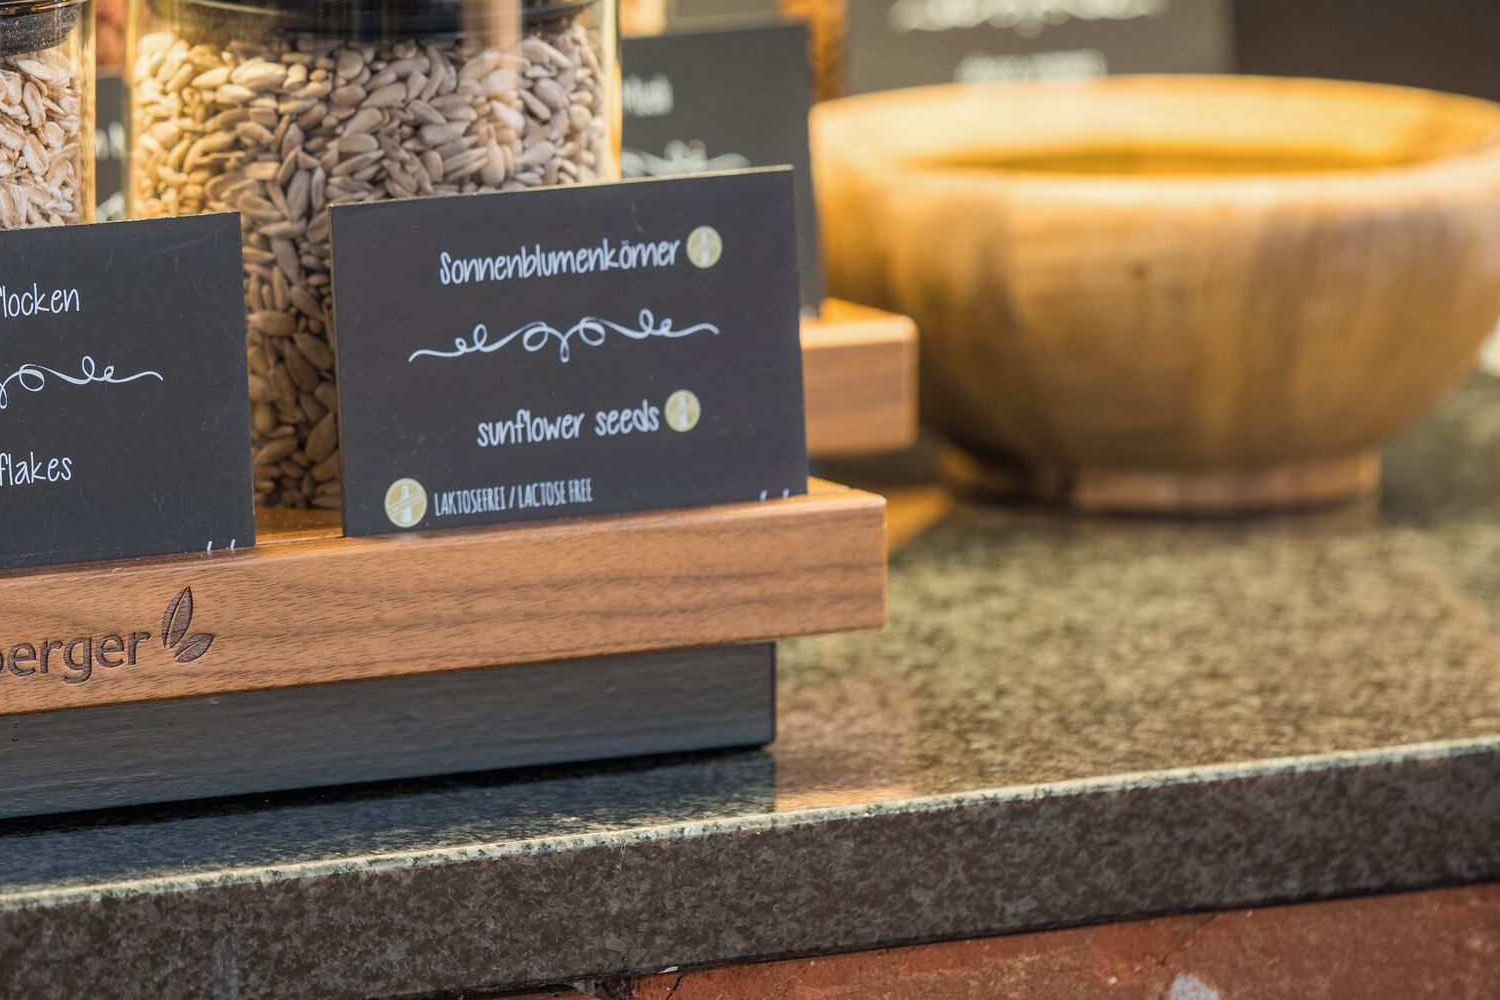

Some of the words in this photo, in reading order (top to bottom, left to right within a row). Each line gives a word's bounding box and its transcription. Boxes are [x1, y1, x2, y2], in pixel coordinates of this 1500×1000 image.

[439, 237, 681, 285] Sonnenblumenkörner
[476, 408, 586, 448] sunflower
[594, 398, 660, 437] seeds
[433, 486, 506, 517] LAKTOSEFREI
[518, 480, 567, 509] LACTOSE
[568, 477, 593, 503] FREE
